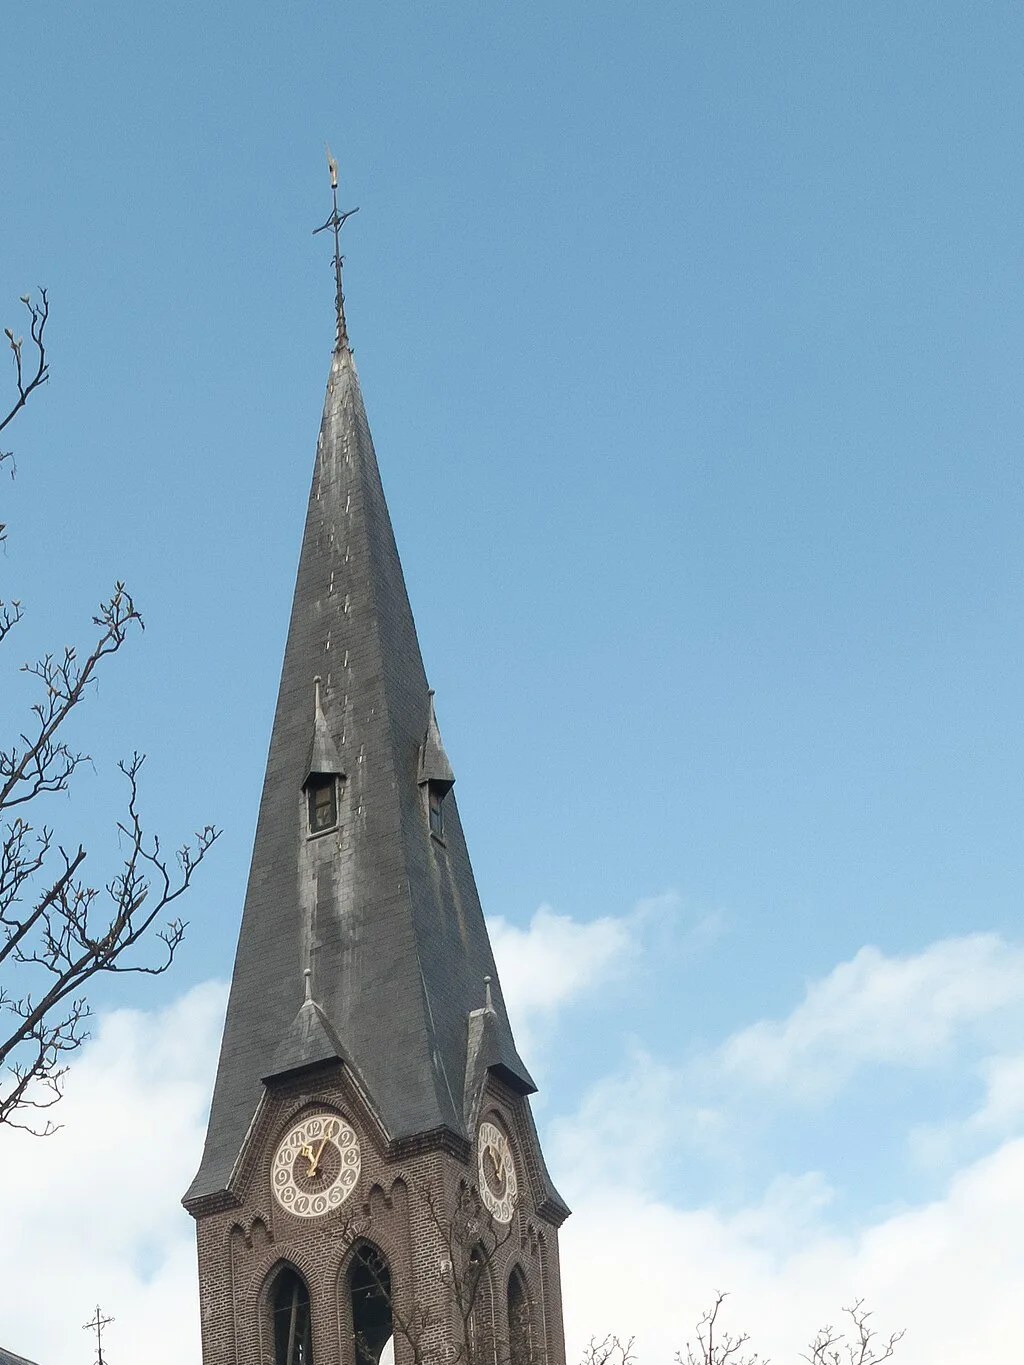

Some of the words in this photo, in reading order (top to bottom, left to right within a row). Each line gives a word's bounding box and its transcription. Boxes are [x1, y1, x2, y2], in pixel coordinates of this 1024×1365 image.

[309, 1121, 320, 1136] 12
[292, 1132, 302, 1146] 11
[341, 1131, 350, 1146] 2
[281, 1150, 293, 1166] 10
[347, 1149, 357, 1164] 3
[278, 1170, 287, 1185] 9
[344, 1170, 354, 1185] 4
[284, 1187, 293, 1203] 8
[332, 1187, 341, 1202] 5
[297, 1197, 305, 1212] 7
[315, 1197, 324, 1212] 6
